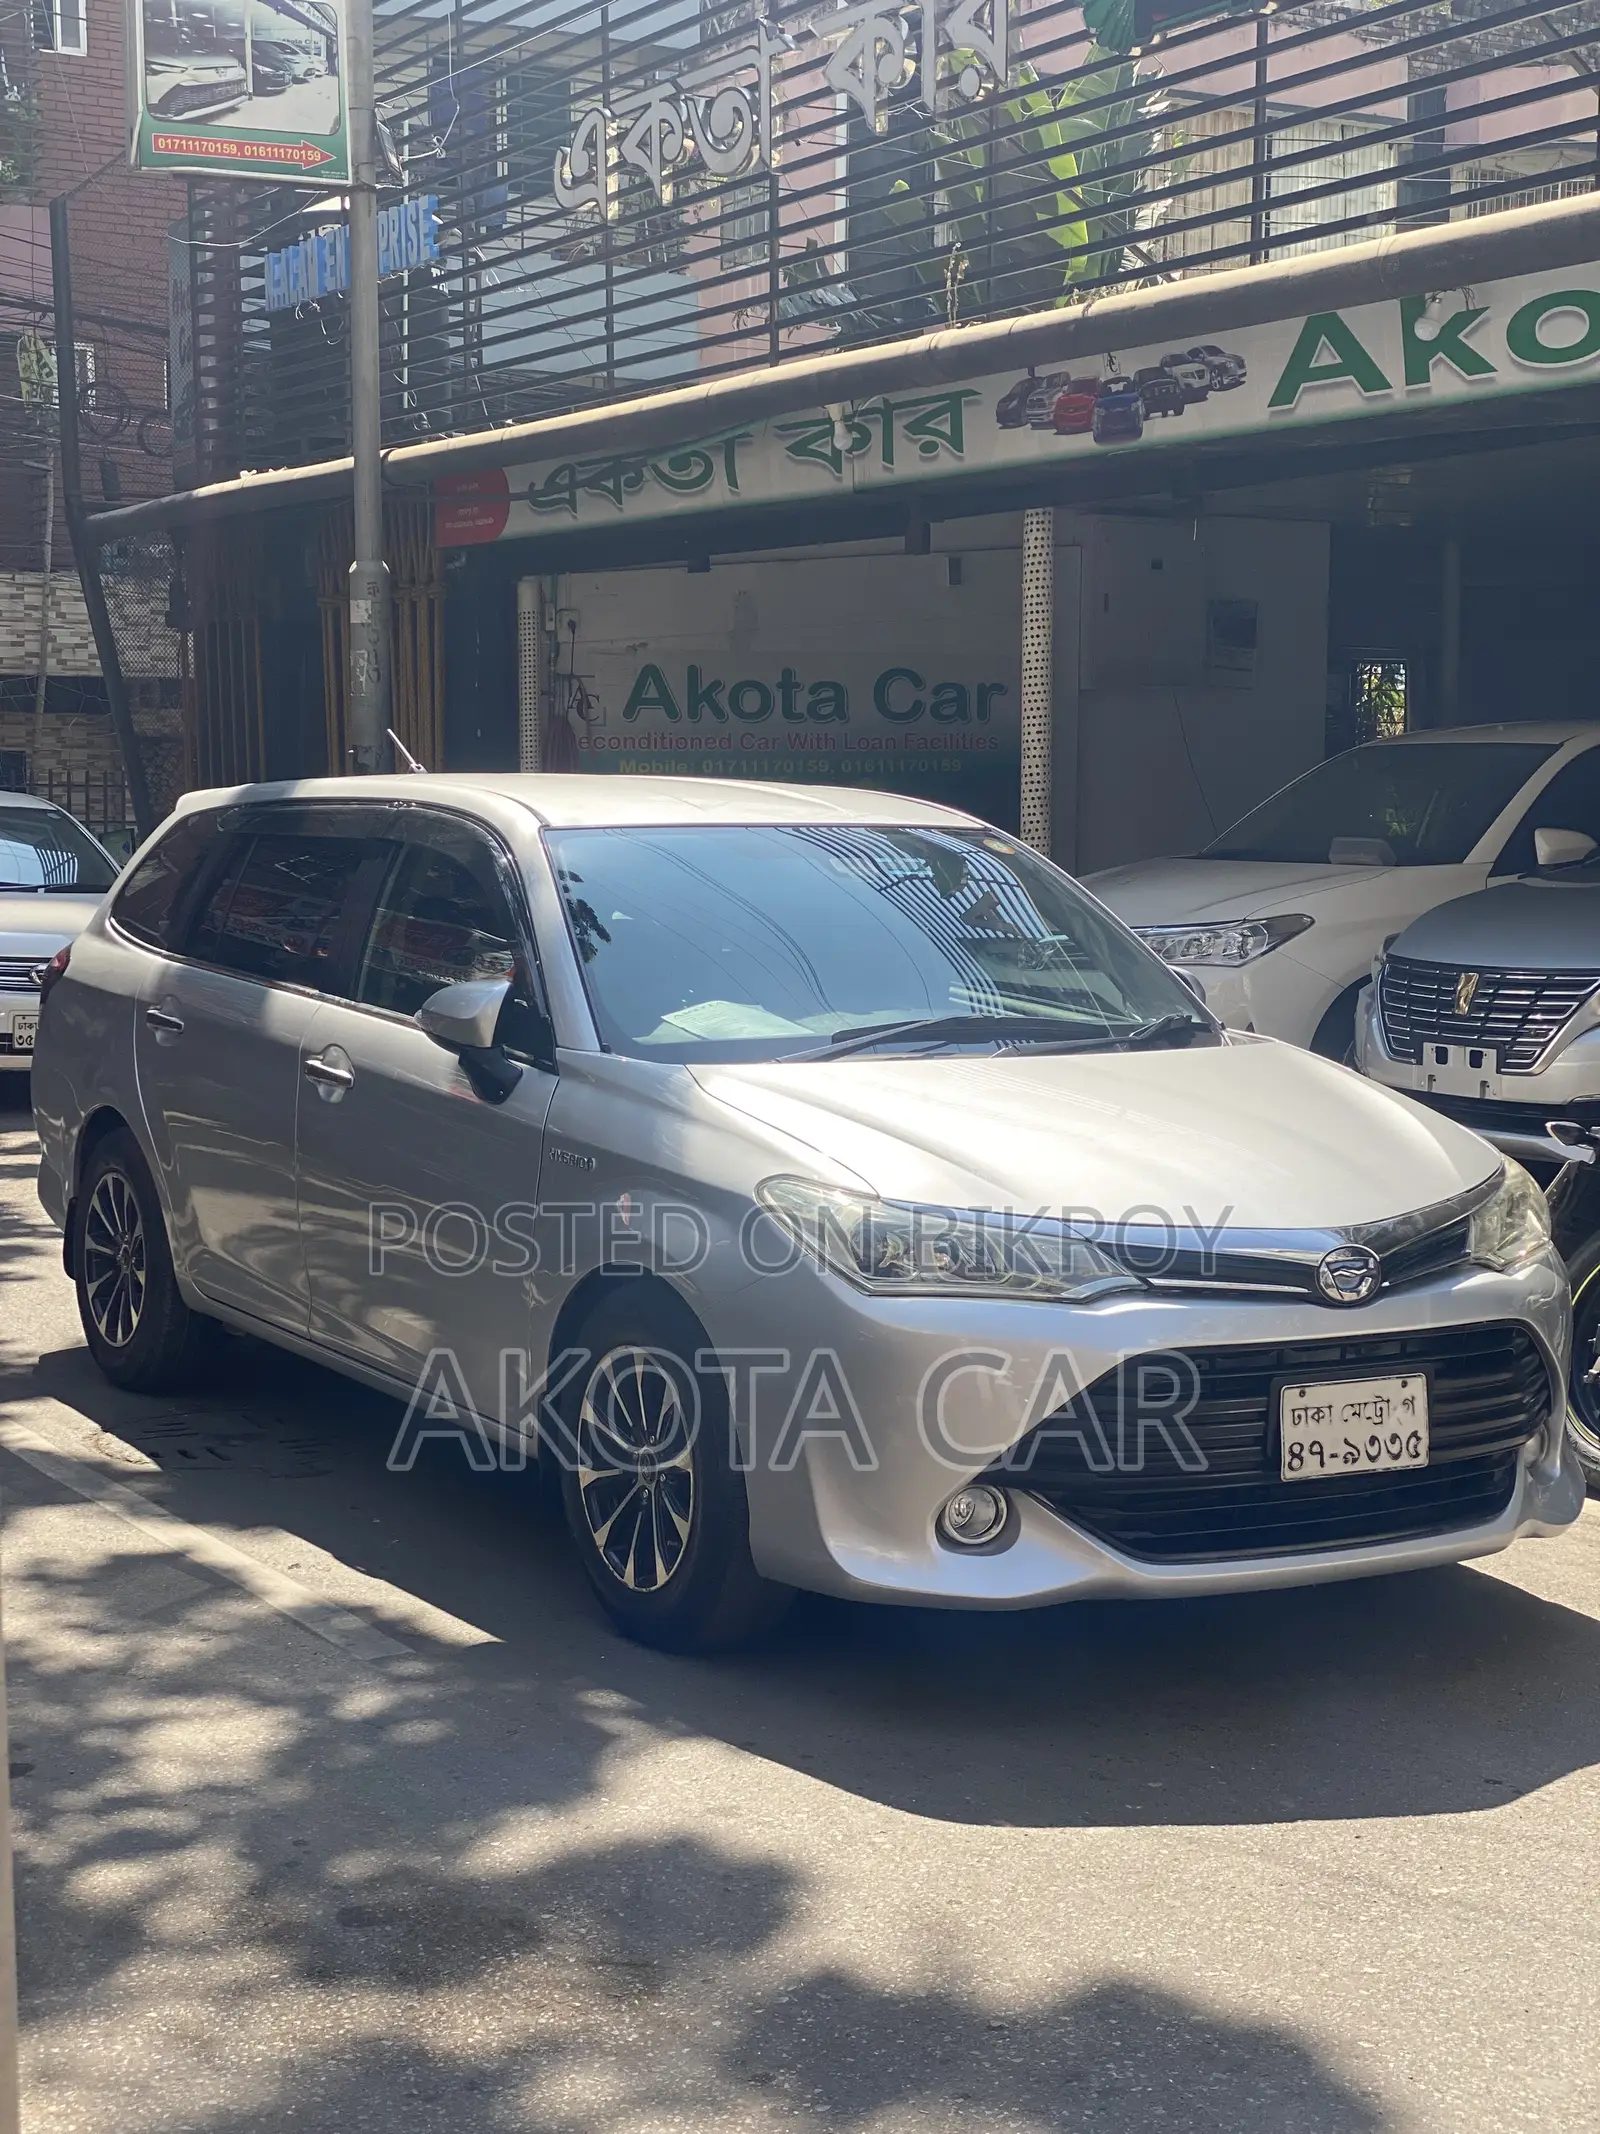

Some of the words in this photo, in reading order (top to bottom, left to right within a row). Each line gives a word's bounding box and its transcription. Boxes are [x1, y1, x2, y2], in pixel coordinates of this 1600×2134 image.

[554, 17, 794, 219] একতা
[808, 0, 1014, 135] কার
[244, 145, 321, 162] 01611170159
[527, 432, 754, 515] একতা
[774, 388, 984, 475] কার
[622, 663, 849, 724] Akota
[872, 667, 1007, 724] Car
[577, 731, 733, 752] econditioned
[739, 731, 780, 752] Car
[786, 731, 837, 751] With
[843, 732, 897, 751] Loan
[903, 732, 1000, 752] Facilities
[619, 758, 696, 774] Mobile:
[17, 1022, 37, 1031] ঢাক
[1291, 1404, 1333, 1427] ঢাকা
[1341, 1395, 1391, 1426] মেট্রো
[1287, 1429, 1423, 1473] ৪৭-৯৩৩৫
